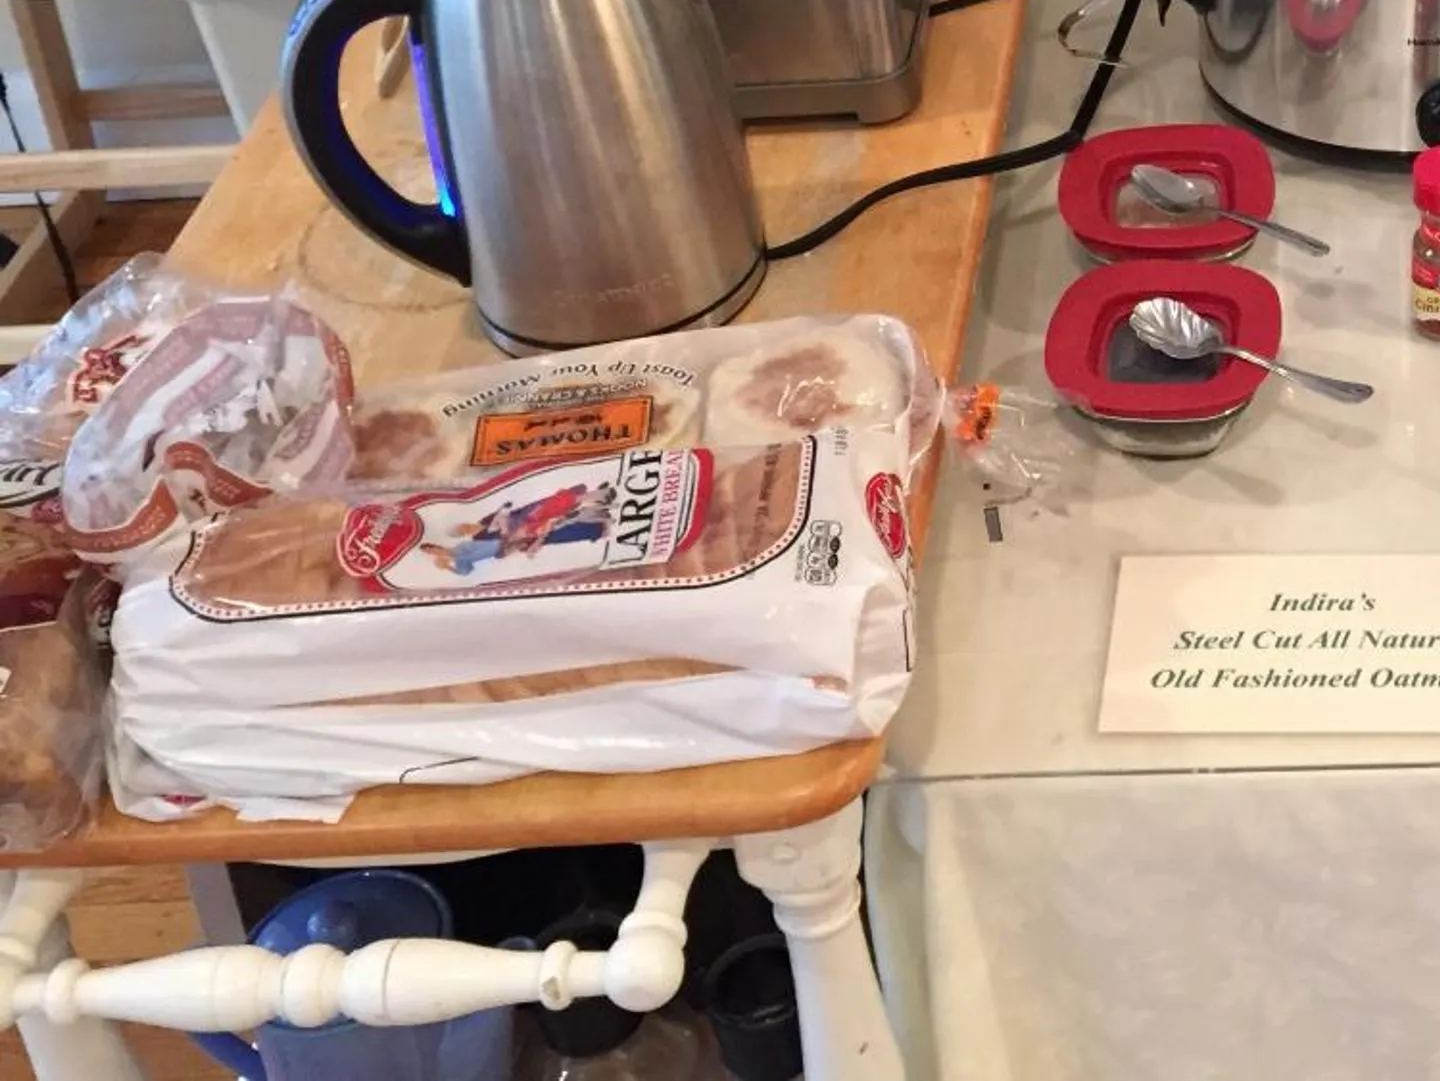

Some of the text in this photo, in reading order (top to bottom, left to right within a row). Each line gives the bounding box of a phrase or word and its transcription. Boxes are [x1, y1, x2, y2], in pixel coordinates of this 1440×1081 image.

[551, 363, 601, 377] Your
[607, 360, 636, 376] Up
[643, 363, 695, 387] Toast
[441, 373, 542, 419] Morning
[1268, 592, 1377, 613] Indira's
[1173, 629, 1245, 651] Steel
[1252, 630, 1304, 651] Cut
[1307, 630, 1352, 650] All
[1150, 668, 1204, 690] Old
[1211, 667, 1363, 689] Fashioned
